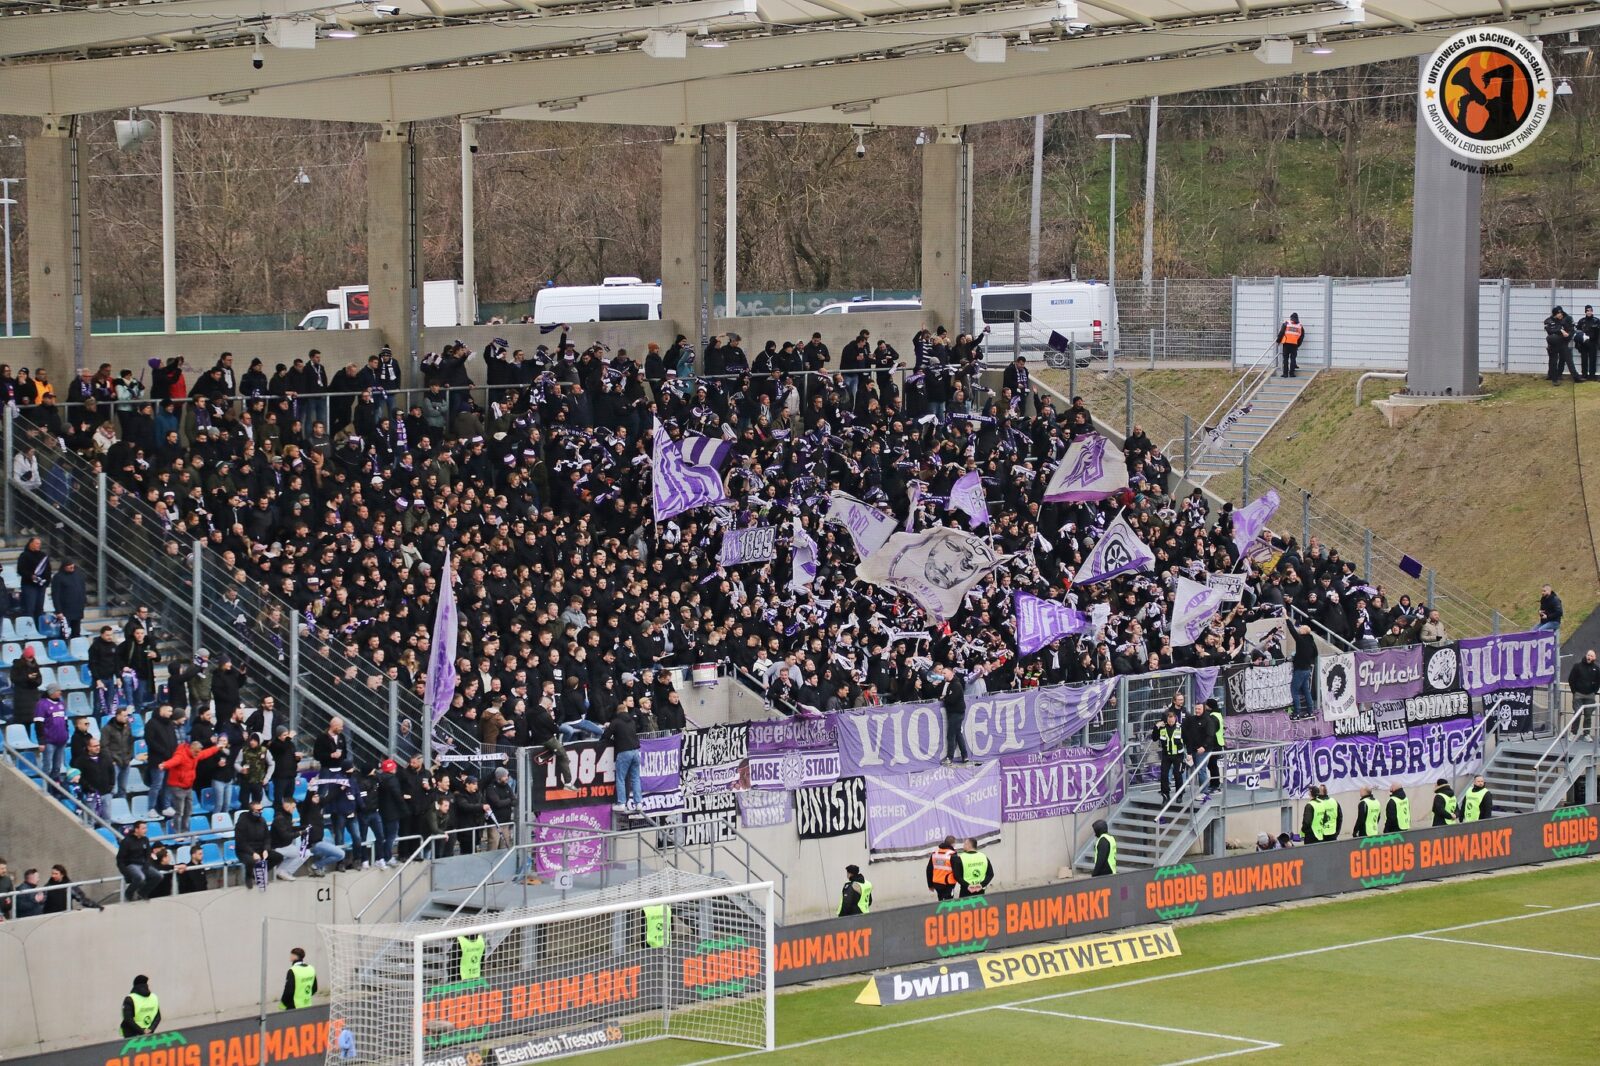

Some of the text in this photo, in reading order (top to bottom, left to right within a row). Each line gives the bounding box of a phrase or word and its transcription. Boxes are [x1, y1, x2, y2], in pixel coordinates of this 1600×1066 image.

[1359, 660, 1421, 693] Fighters
[1460, 636, 1555, 690] HÜTTE
[1405, 691, 1469, 723] BOHMTE
[851, 697, 1025, 767] VIOET
[751, 763, 780, 781] HASE
[1313, 726, 1483, 783] OSNABRÜCK
[578, 785, 616, 798] IS NOW
[1005, 763, 1100, 808] EIMER
[1246, 774, 1260, 788] C2
[686, 811, 736, 846] ARMEE
[870, 805, 907, 818] BREMER
[1532, 817, 1597, 848] GLOBUS
[1350, 828, 1512, 878] GLOBUS BAUMARKT
[316, 888, 331, 902] C1
[1146, 859, 1303, 910] GLOBUS BAUMARKT
[925, 888, 1111, 947] GLOBUS BAUMARKT
[683, 946, 760, 988] GLOBUS
[894, 931, 1174, 1000] bwin SPORTWETTEN
[511, 965, 641, 1020] BAUMARKT
